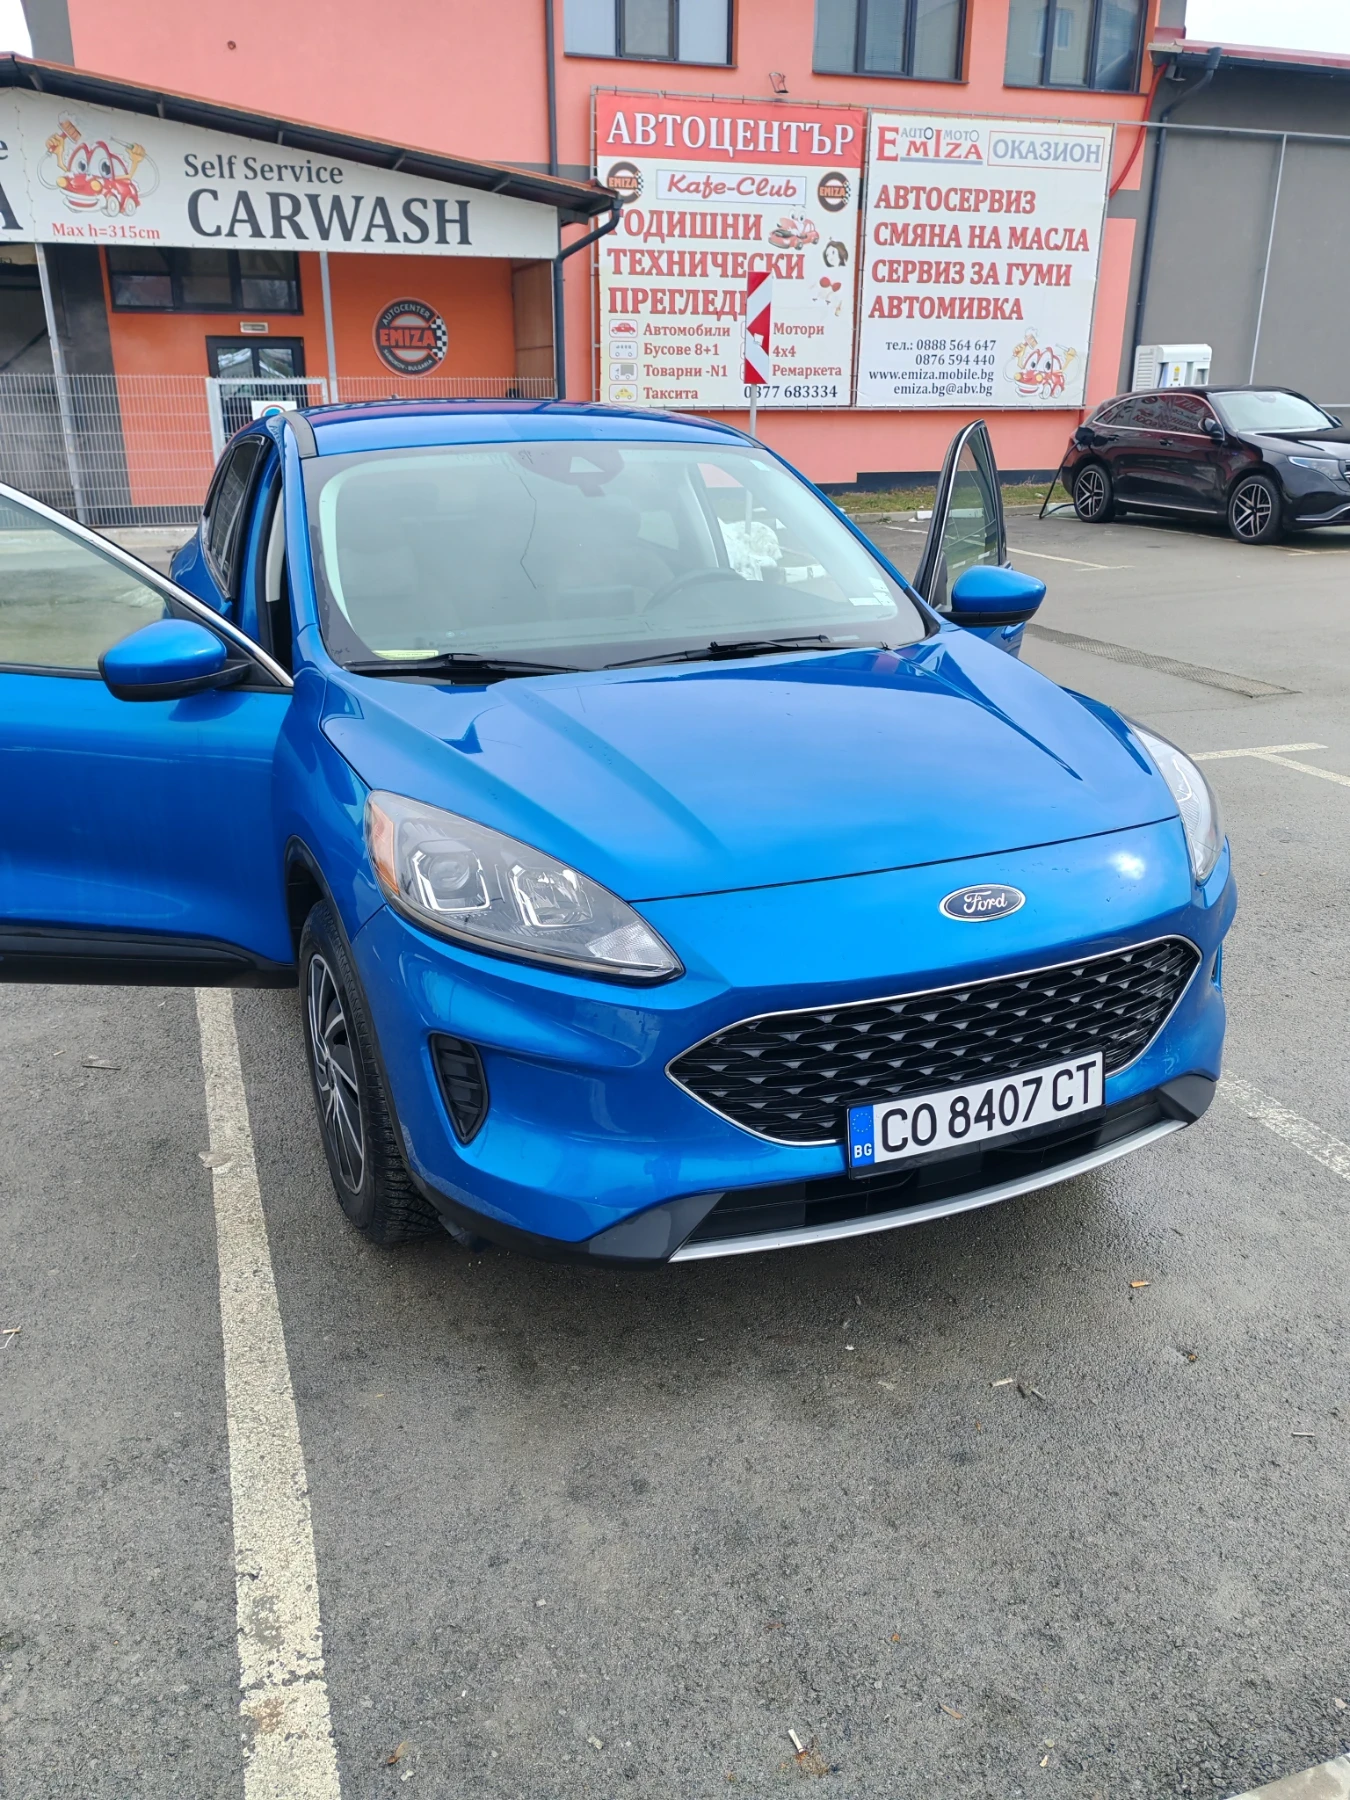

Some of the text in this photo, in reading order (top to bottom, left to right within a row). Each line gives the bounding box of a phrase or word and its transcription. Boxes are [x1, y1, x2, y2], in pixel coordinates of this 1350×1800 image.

[606, 110, 855, 158] АВТОЦЕНТЪР
[901, 127, 934, 140] AUTO
[943, 130, 979, 142] MOTO
[992, 139, 1101, 164] ОКАЗИОН
[184, 154, 343, 184] Self Service
[609, 177, 638, 188] EMIZA
[667, 173, 797, 199] Kafe-Club
[820, 187, 846, 197] EMIZA
[874, 184, 1036, 215] АВТОСЕРВИЗ
[187, 188, 473, 246] CARWASH
[52, 223, 160, 240] Max h=315cm
[873, 222, 1089, 252] СМЯНА НА МАСЛА
[606, 248, 805, 280] ТЕХНИЧЕСКИ
[871, 259, 1072, 286] СЕРВИЗ ЗА ГУМИ
[382, 304, 430, 326] AUTOCENTER
[868, 296, 1024, 321] АВТОМИВКА
[380, 328, 436, 346] EMIZA
[643, 323, 730, 337] Автомобили
[773, 322, 824, 338] Мотори
[643, 343, 719, 358] Бусове 8+1
[886, 339, 996, 351] тел.: 0888 564 647
[916, 354, 995, 366] 0876 594 440
[643, 365, 702, 380] Товарни
[772, 365, 842, 380] Ремаркета
[869, 368, 994, 382] www.emiza.mobile.bg
[643, 386, 698, 399] Таксита
[784, 385, 838, 398] 683334
[894, 383, 993, 397] emiza.bg@abv.bg
[963, 890, 1007, 913] Ford
[881, 1060, 1097, 1152] CO 8407 CT
[854, 1143, 872, 1159] BG
